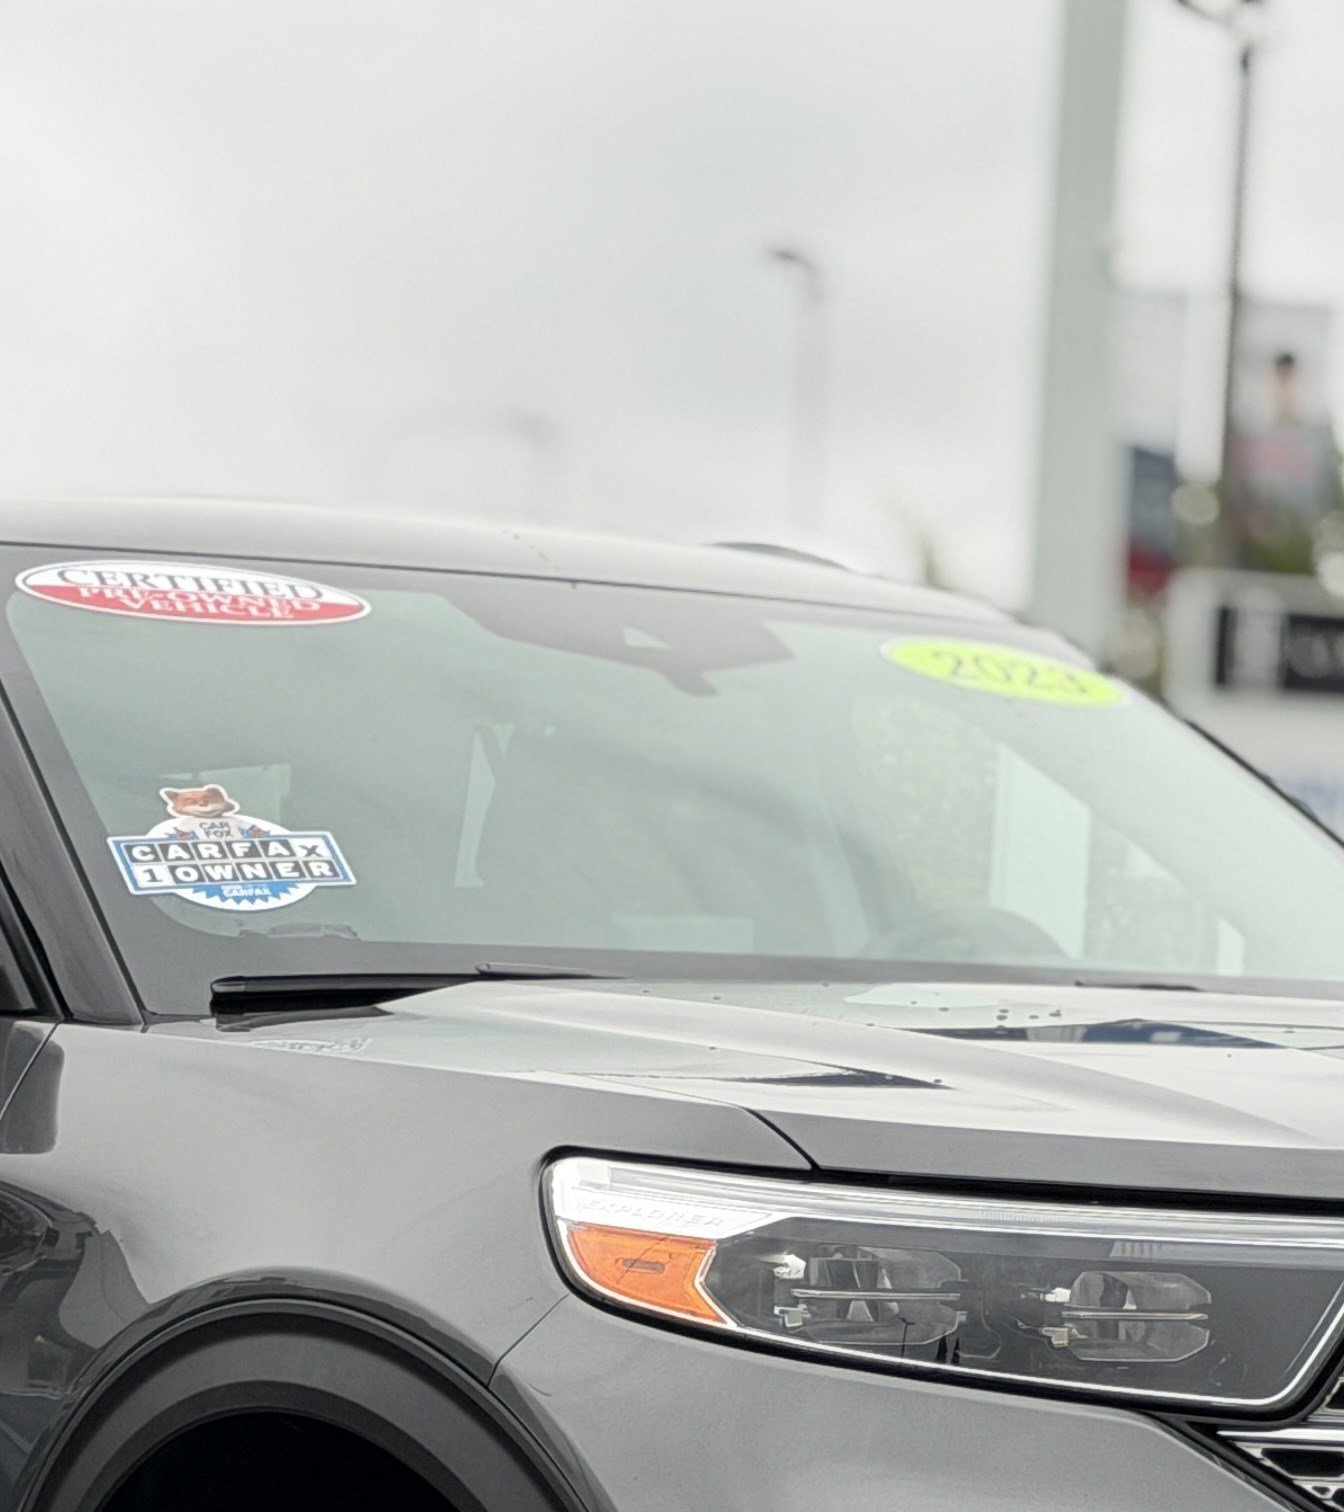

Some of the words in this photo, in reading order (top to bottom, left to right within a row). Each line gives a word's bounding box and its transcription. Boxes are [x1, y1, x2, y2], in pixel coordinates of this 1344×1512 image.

[56, 567, 324, 601] CERTIFIED
[117, 597, 294, 619] VEHICLE
[130, 841, 326, 862] CARFAX
[140, 867, 164, 884] 1
[174, 862, 336, 883] OWNER
[583, 1199, 726, 1228] EXPLORER
